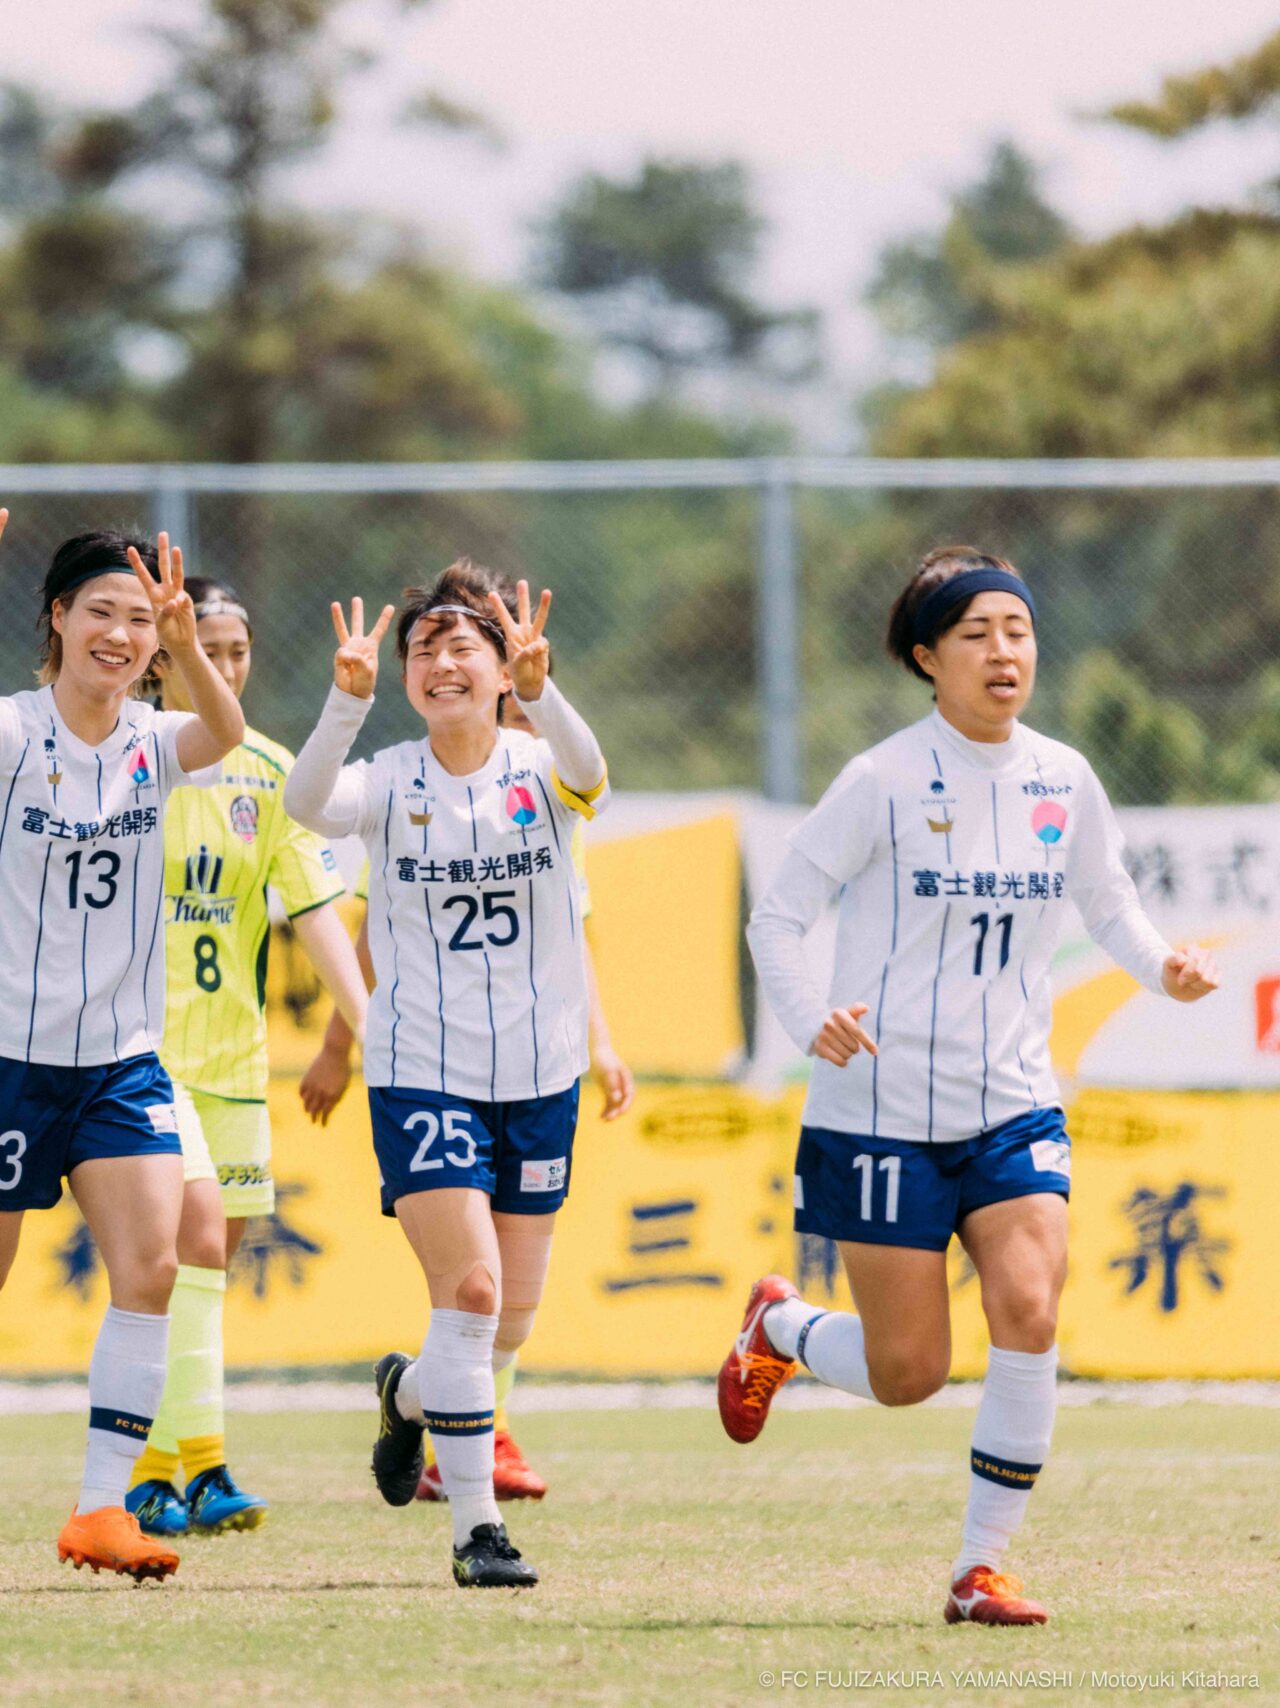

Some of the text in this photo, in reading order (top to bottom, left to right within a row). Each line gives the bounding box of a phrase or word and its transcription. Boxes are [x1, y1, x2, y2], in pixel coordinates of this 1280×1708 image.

[65, 850, 121, 909] 13
[396, 847, 554, 883] 富士観光開発
[442, 890, 520, 951] 25
[970, 913, 1015, 976] 11
[194, 935, 222, 992] 8
[403, 1110, 478, 1172] 25
[852, 1153, 901, 1222] 11
